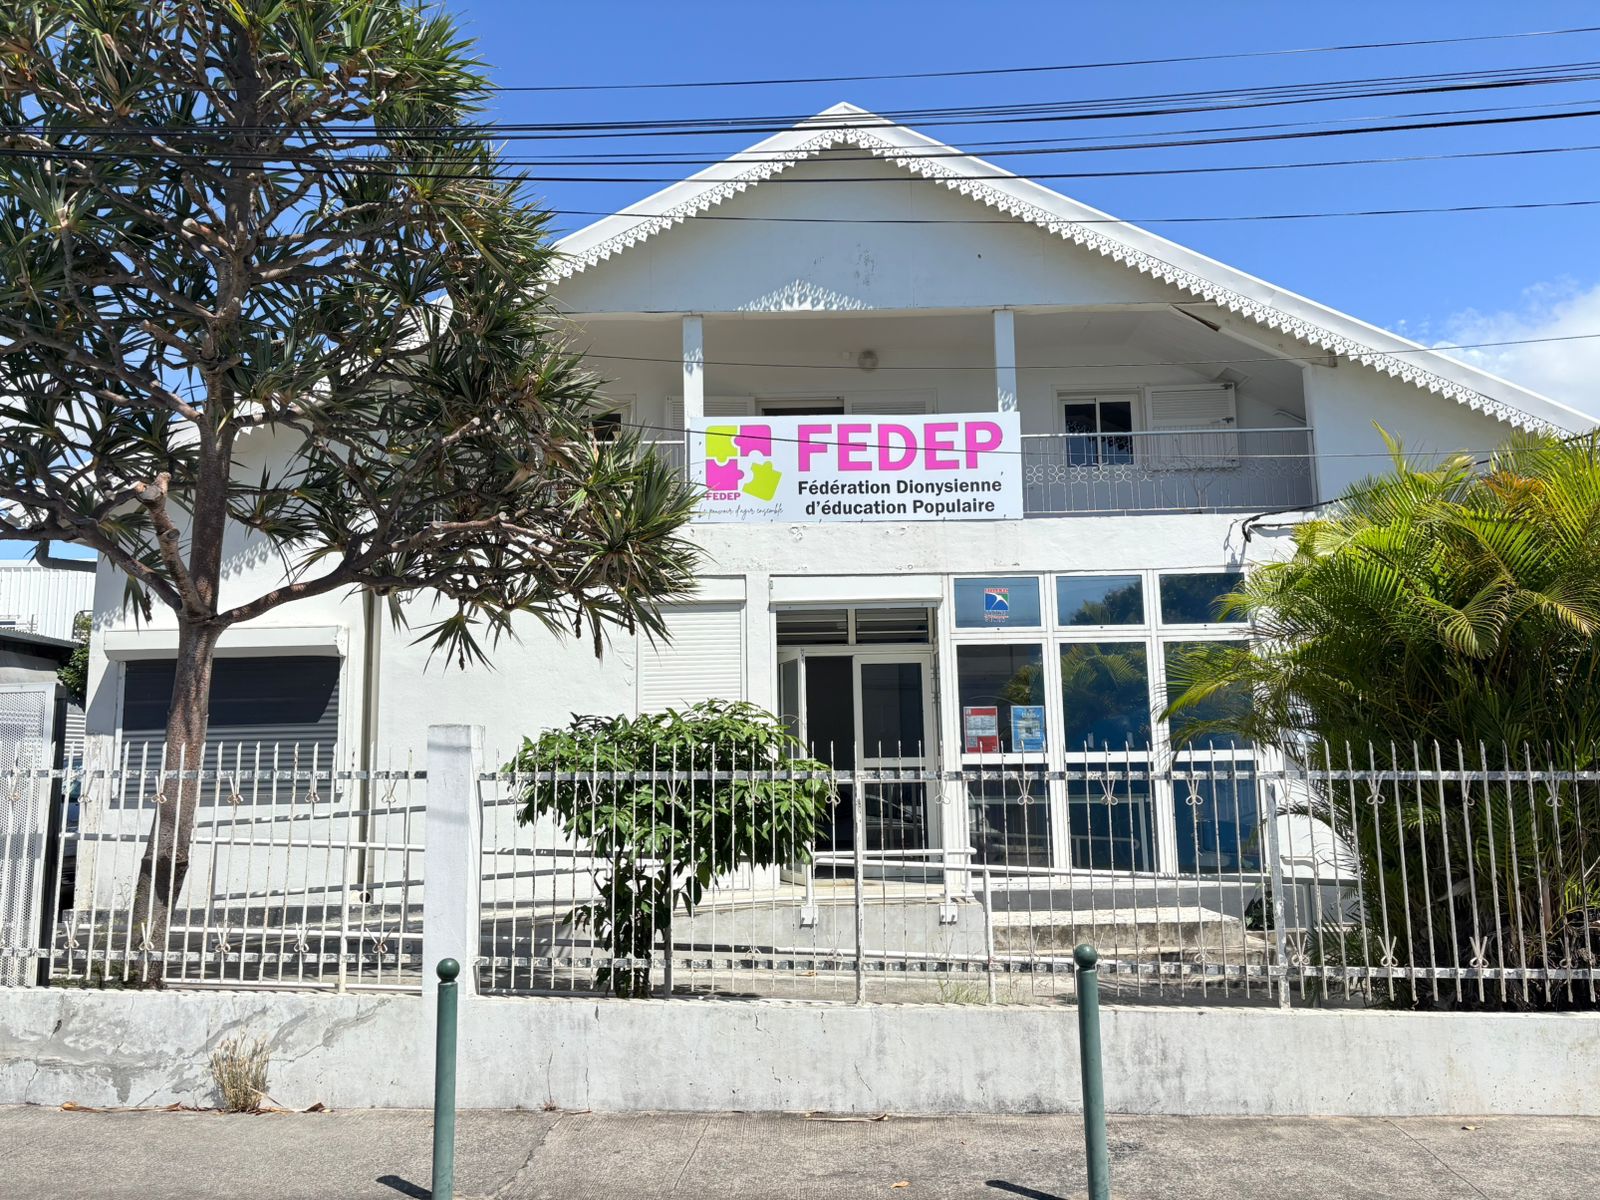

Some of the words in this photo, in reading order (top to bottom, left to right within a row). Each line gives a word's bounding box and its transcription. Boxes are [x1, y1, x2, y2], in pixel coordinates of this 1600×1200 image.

[798, 421, 1004, 472] FEDEP
[706, 492, 740, 500] FEDEP
[798, 480, 891, 495] Fédération
[896, 478, 1002, 496] Dionysienne
[912, 498, 995, 516] Populaire
